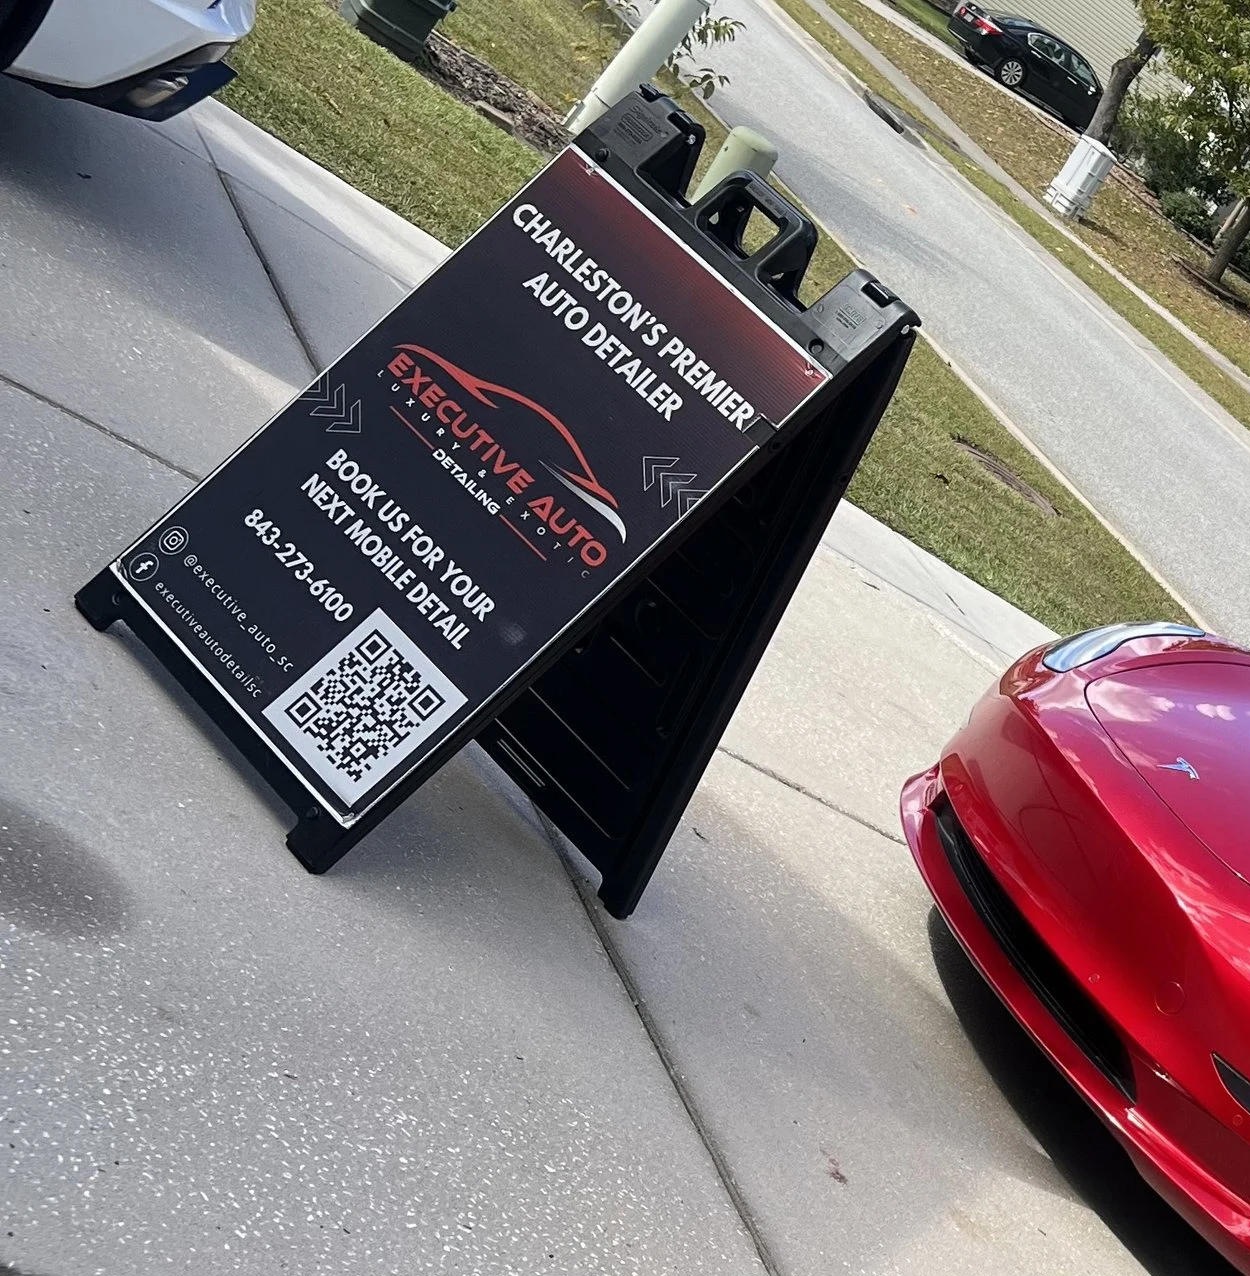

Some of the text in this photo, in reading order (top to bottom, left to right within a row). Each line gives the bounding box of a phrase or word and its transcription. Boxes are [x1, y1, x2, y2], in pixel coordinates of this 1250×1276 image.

[513, 203, 754, 431] CHARLESTON'S PREMIER
[522, 272, 684, 422] AUTO DETAILER
[325, 448, 496, 623] BOOK US FOR YOUR
[377, 369, 590, 579] LUXURY & EXOTIC
[387, 352, 607, 567] EXECUTIVE AUTO
[432, 448, 501, 515] DETAILING
[154, 581, 262, 698] executiveautodetailsc
[183, 554, 294, 673] @executive_auto_sc
[244, 508, 354, 622] 843-273-6100
[300, 472, 471, 650] NEXT MOBILE DETAIL
